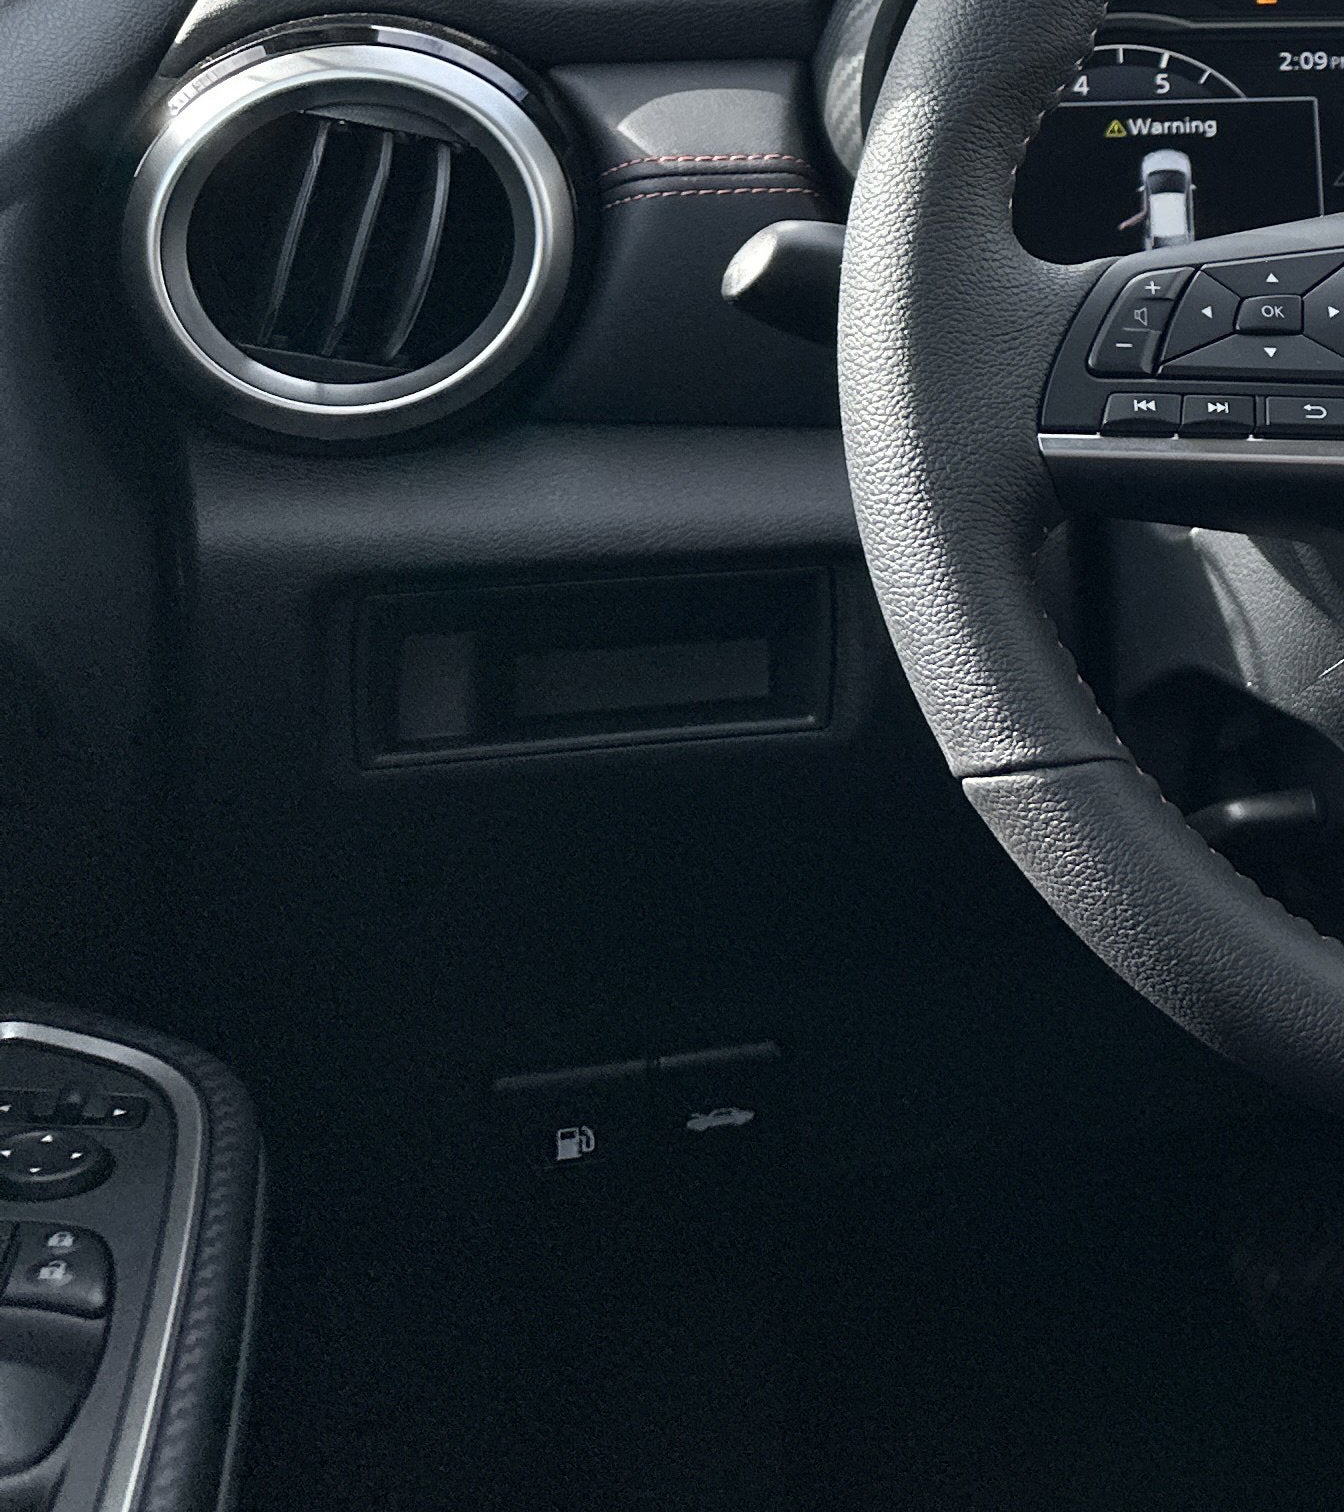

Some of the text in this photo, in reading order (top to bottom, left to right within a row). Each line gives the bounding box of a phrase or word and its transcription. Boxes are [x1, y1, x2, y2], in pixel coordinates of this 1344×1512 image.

[1073, 75, 1090, 96] 4
[1155, 74, 1171, 95] 5
[1129, 117, 1218, 138] Warning
[1261, 305, 1285, 318] OK
